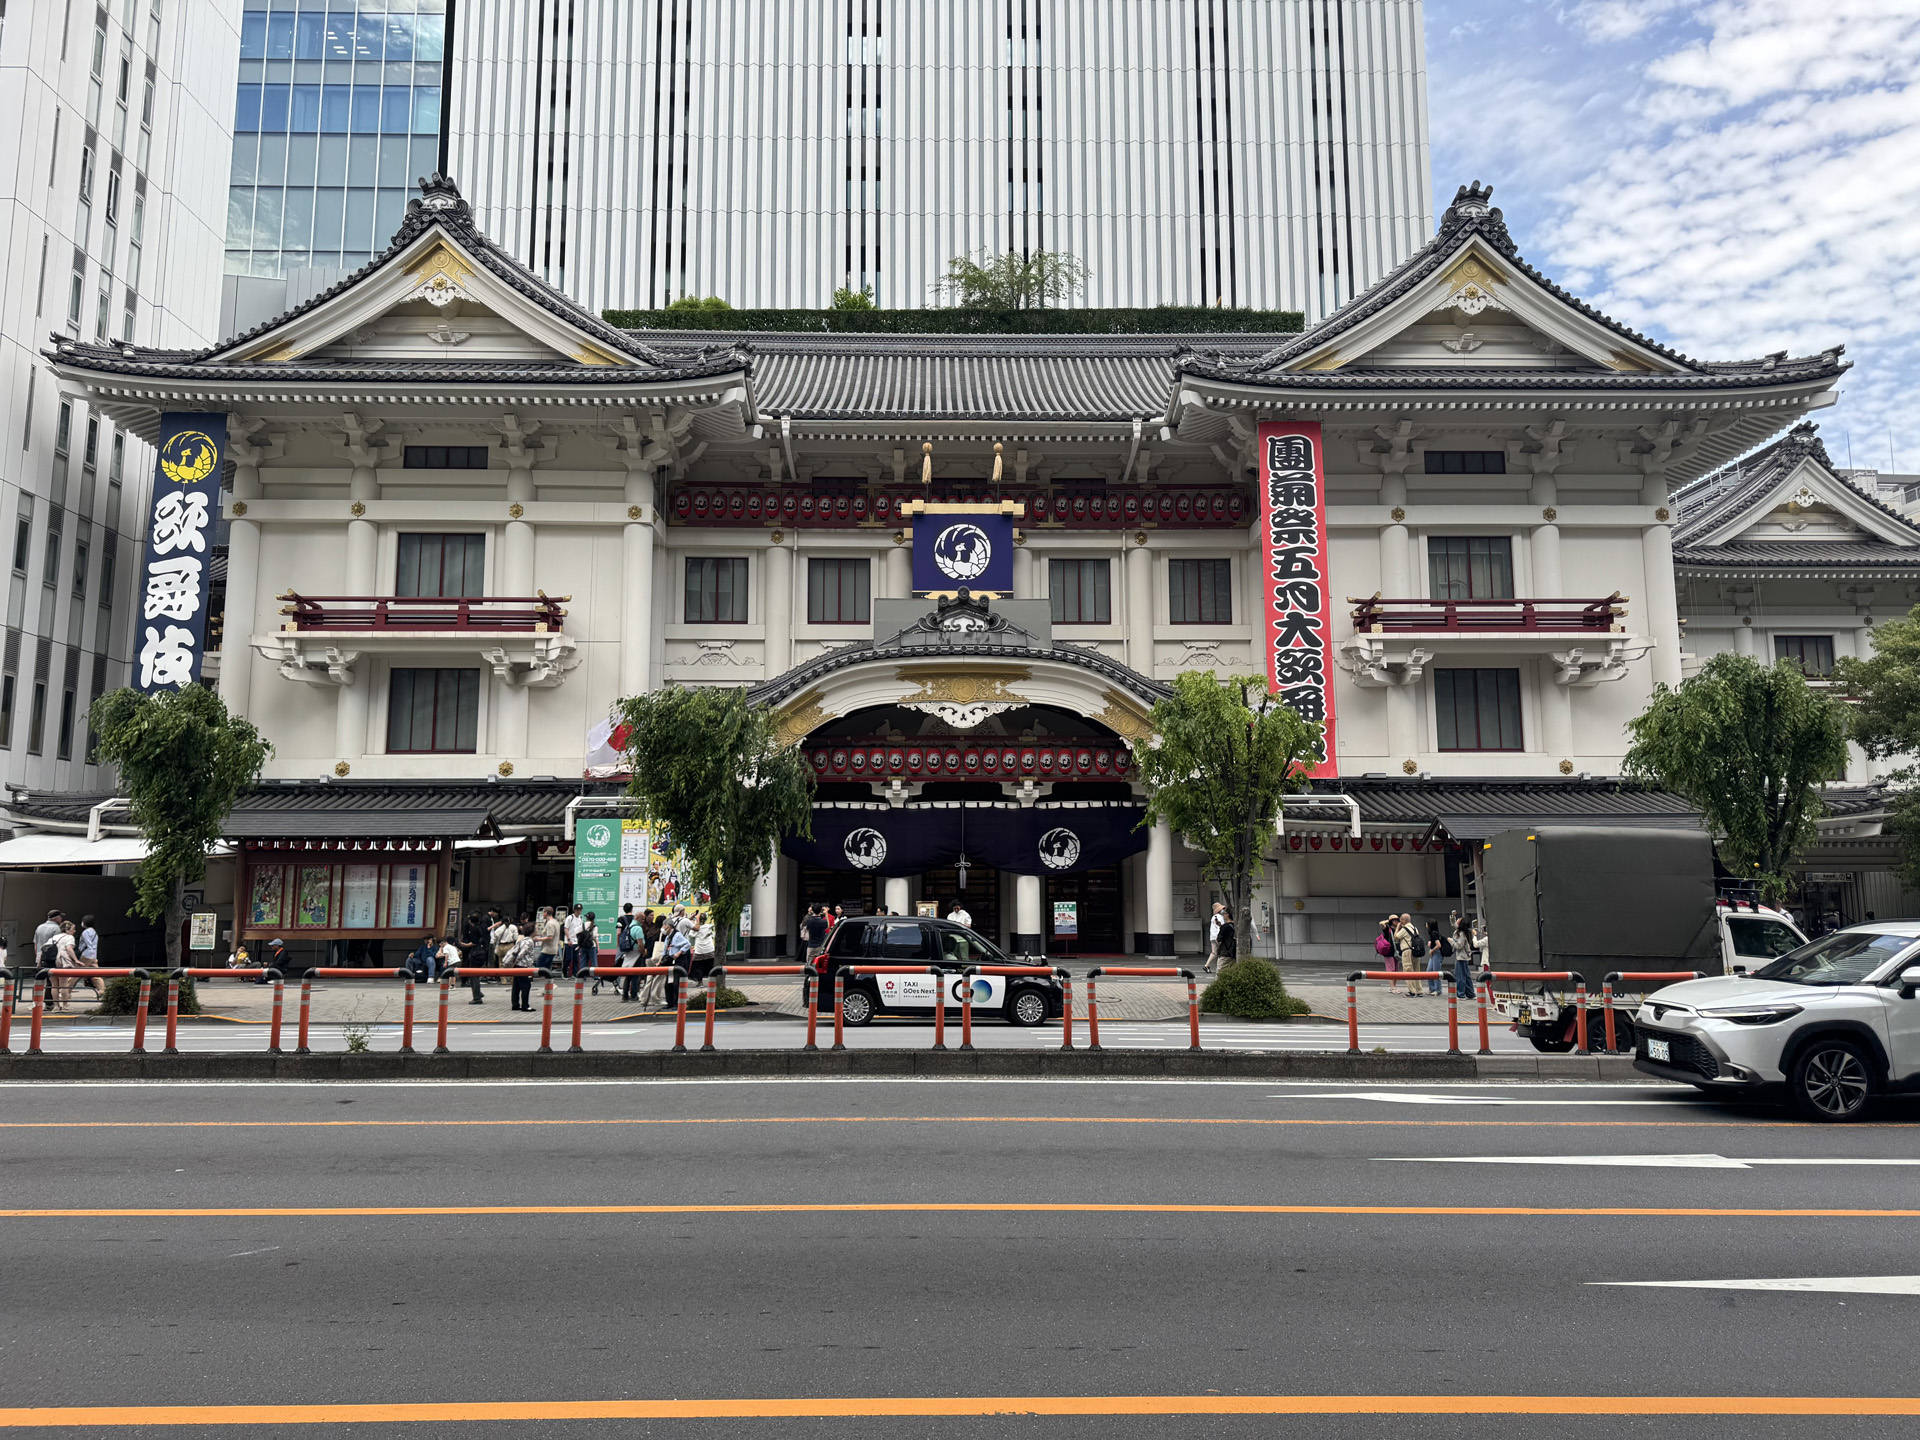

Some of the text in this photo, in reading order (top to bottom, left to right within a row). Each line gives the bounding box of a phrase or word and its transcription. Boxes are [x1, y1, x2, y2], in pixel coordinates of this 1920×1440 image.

[1266, 434, 1329, 764] 團菊祭五月大歌舞
